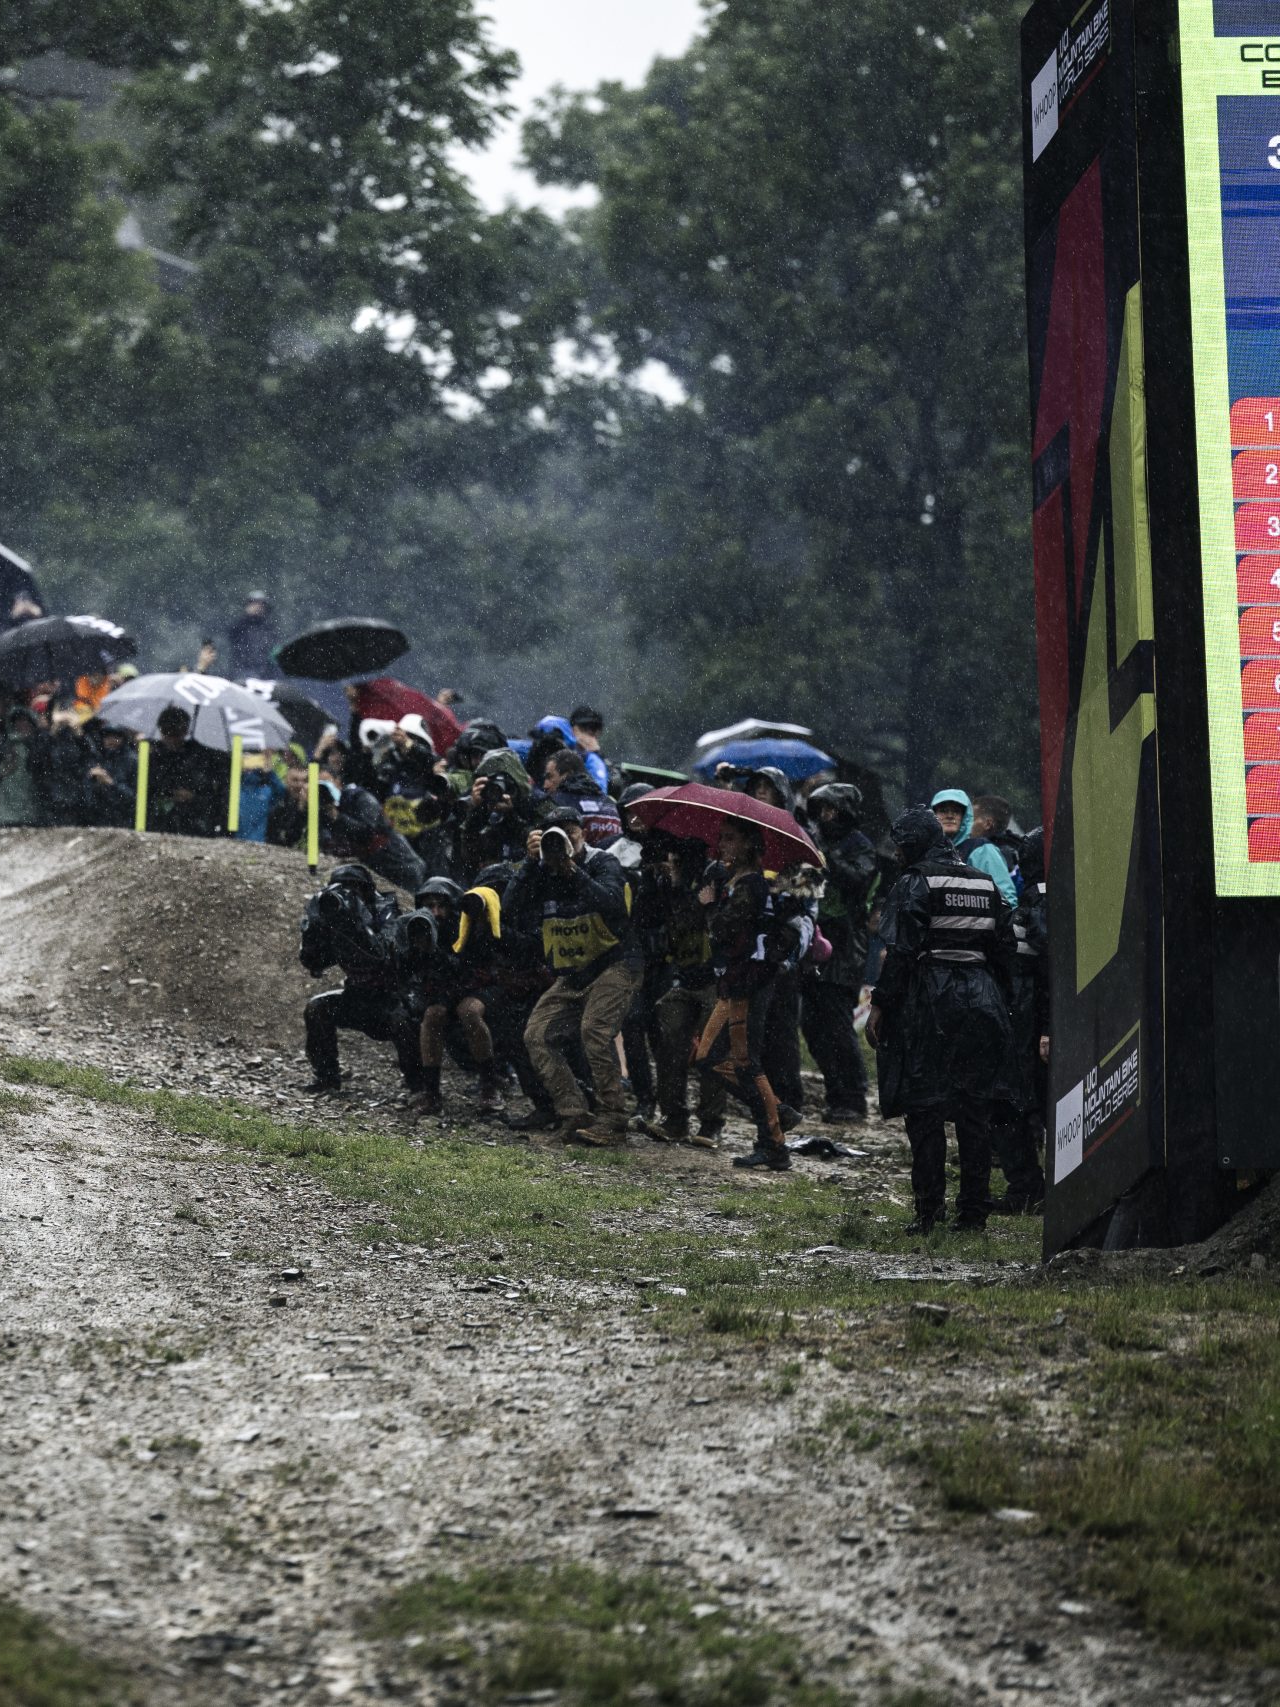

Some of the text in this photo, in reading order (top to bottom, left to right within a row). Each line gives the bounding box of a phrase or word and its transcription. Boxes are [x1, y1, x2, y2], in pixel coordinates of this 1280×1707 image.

[1059, 0, 1109, 82] MOUNTAIN BIKE
[1060, 20, 1109, 103] WORLD SERIES
[1034, 82, 1057, 130] WHOOP
[1264, 412, 1274, 432] 1
[1266, 464, 1279, 485] 2
[1268, 516, 1280, 537] 3
[945, 893, 990, 909] SECURITE
[1084, 1048, 1138, 1119] MOUNTAIN BIKE
[1086, 1065, 1098, 1094] UCI
[1084, 1070, 1138, 1139] WORLD SERIES
[1057, 1114, 1081, 1151] WHOOP
